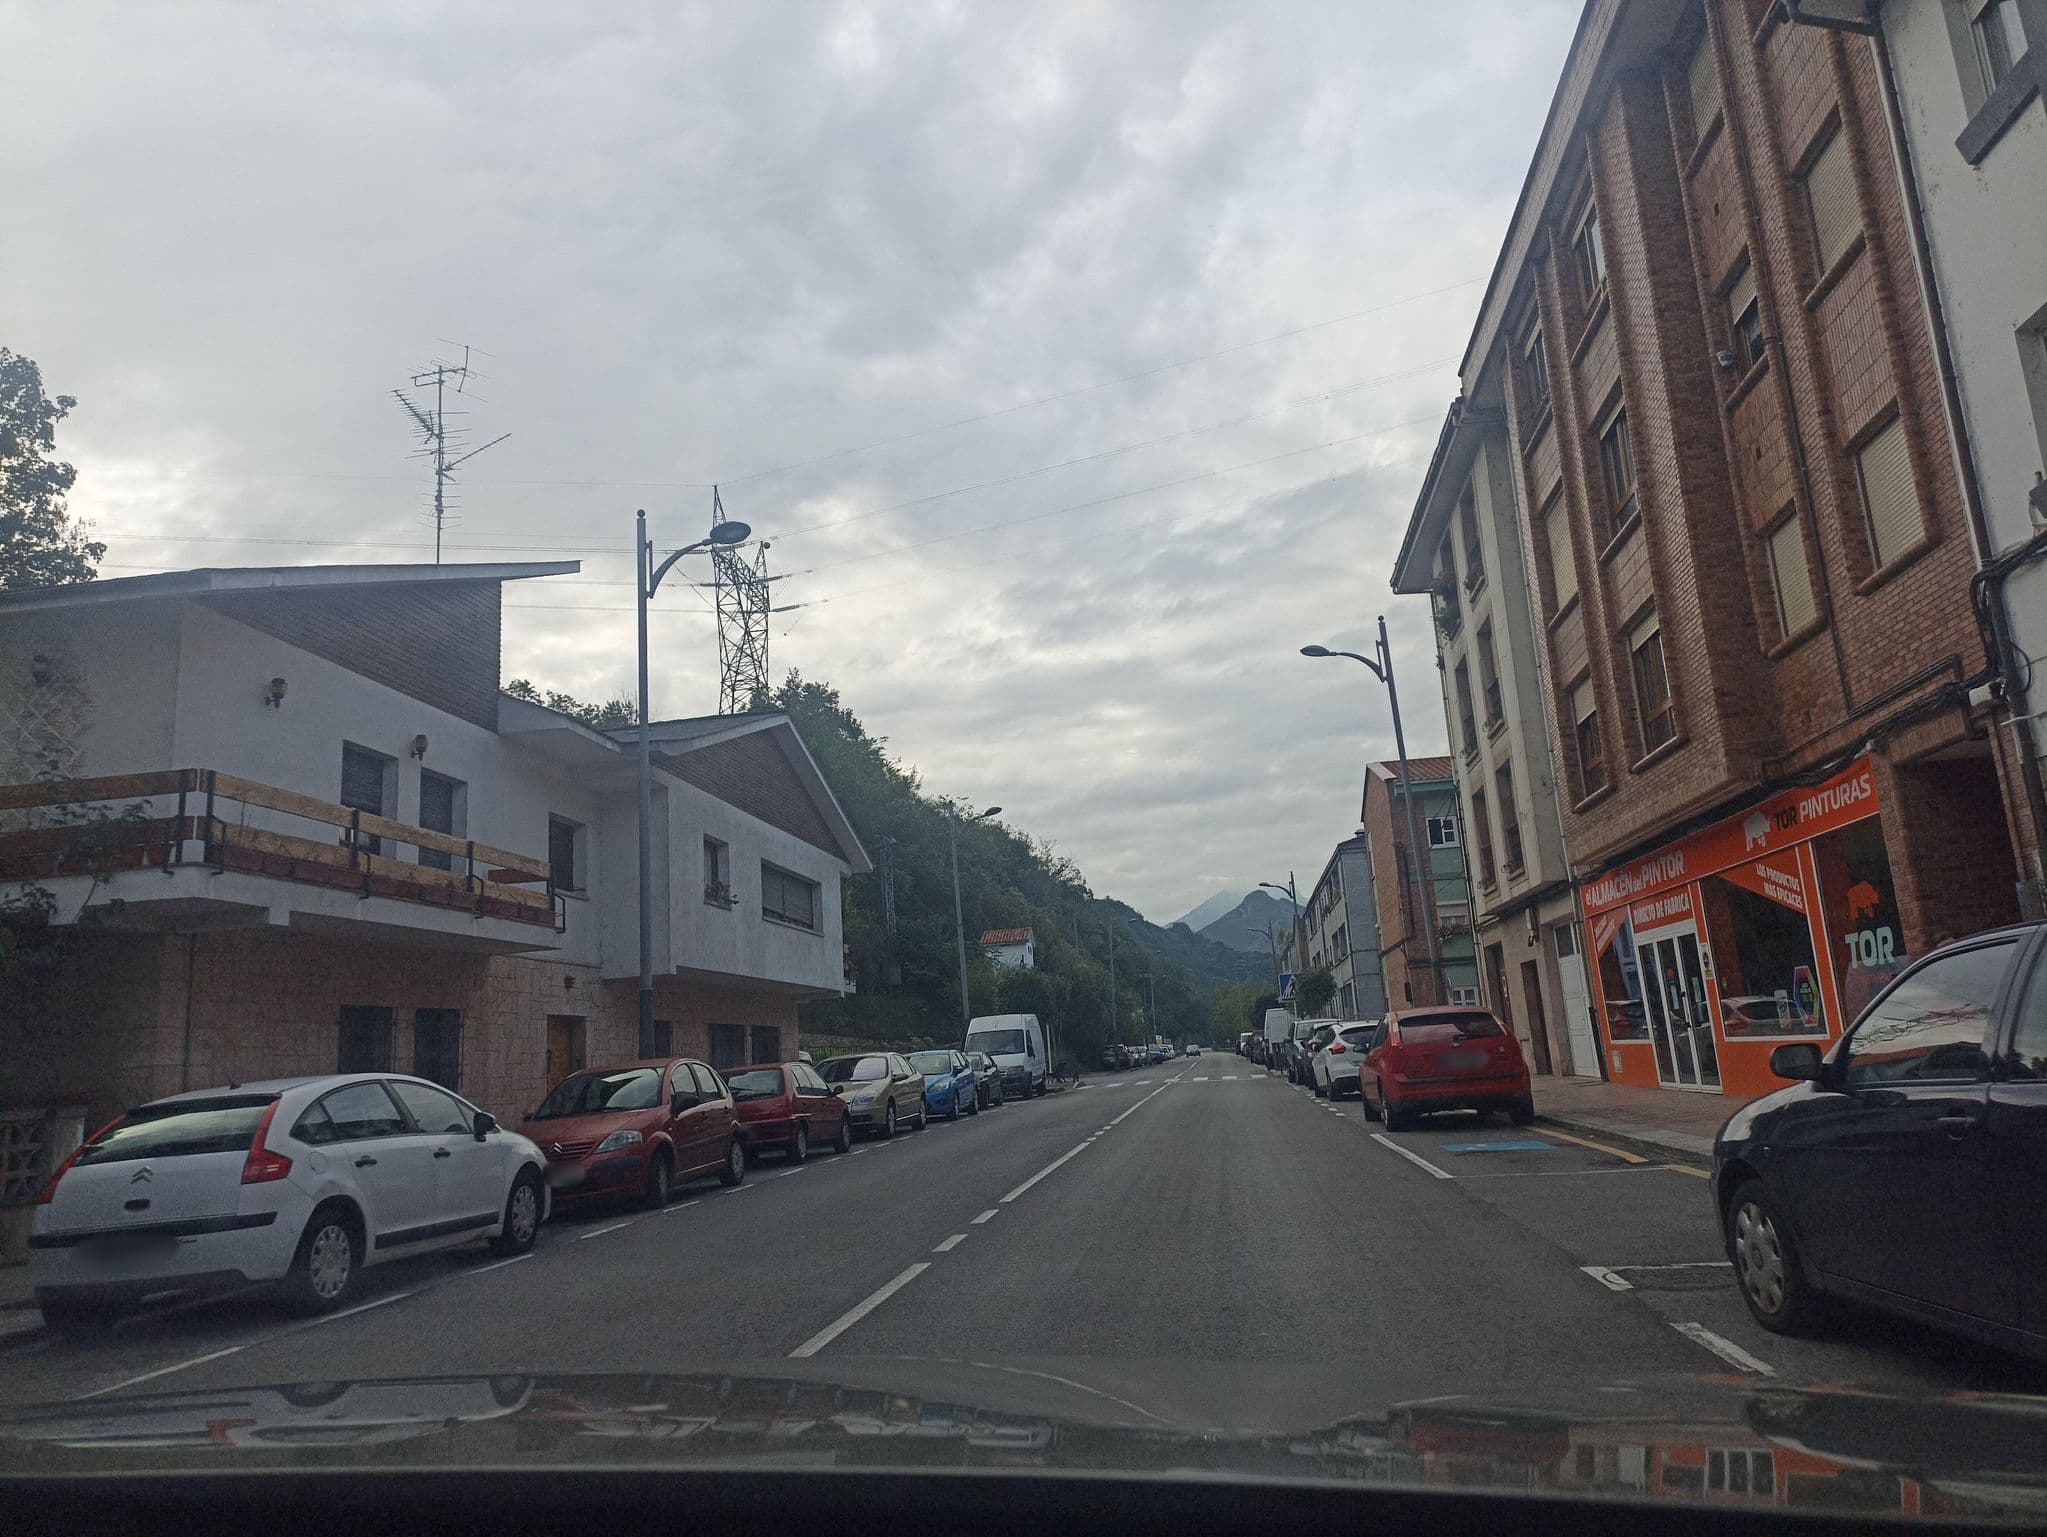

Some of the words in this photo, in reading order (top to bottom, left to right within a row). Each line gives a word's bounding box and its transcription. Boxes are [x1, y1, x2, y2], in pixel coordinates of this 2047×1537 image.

[1775, 806, 1797, 831] TOR
[1800, 773, 1872, 823] PINTURAS
[1641, 849, 1685, 889] PINTOR
[1766, 866, 1801, 892] PRODUCTOS
[1655, 901, 1665, 919] DE
[1776, 886, 1804, 910] EFICACES
[1844, 926, 1896, 969] TOR
